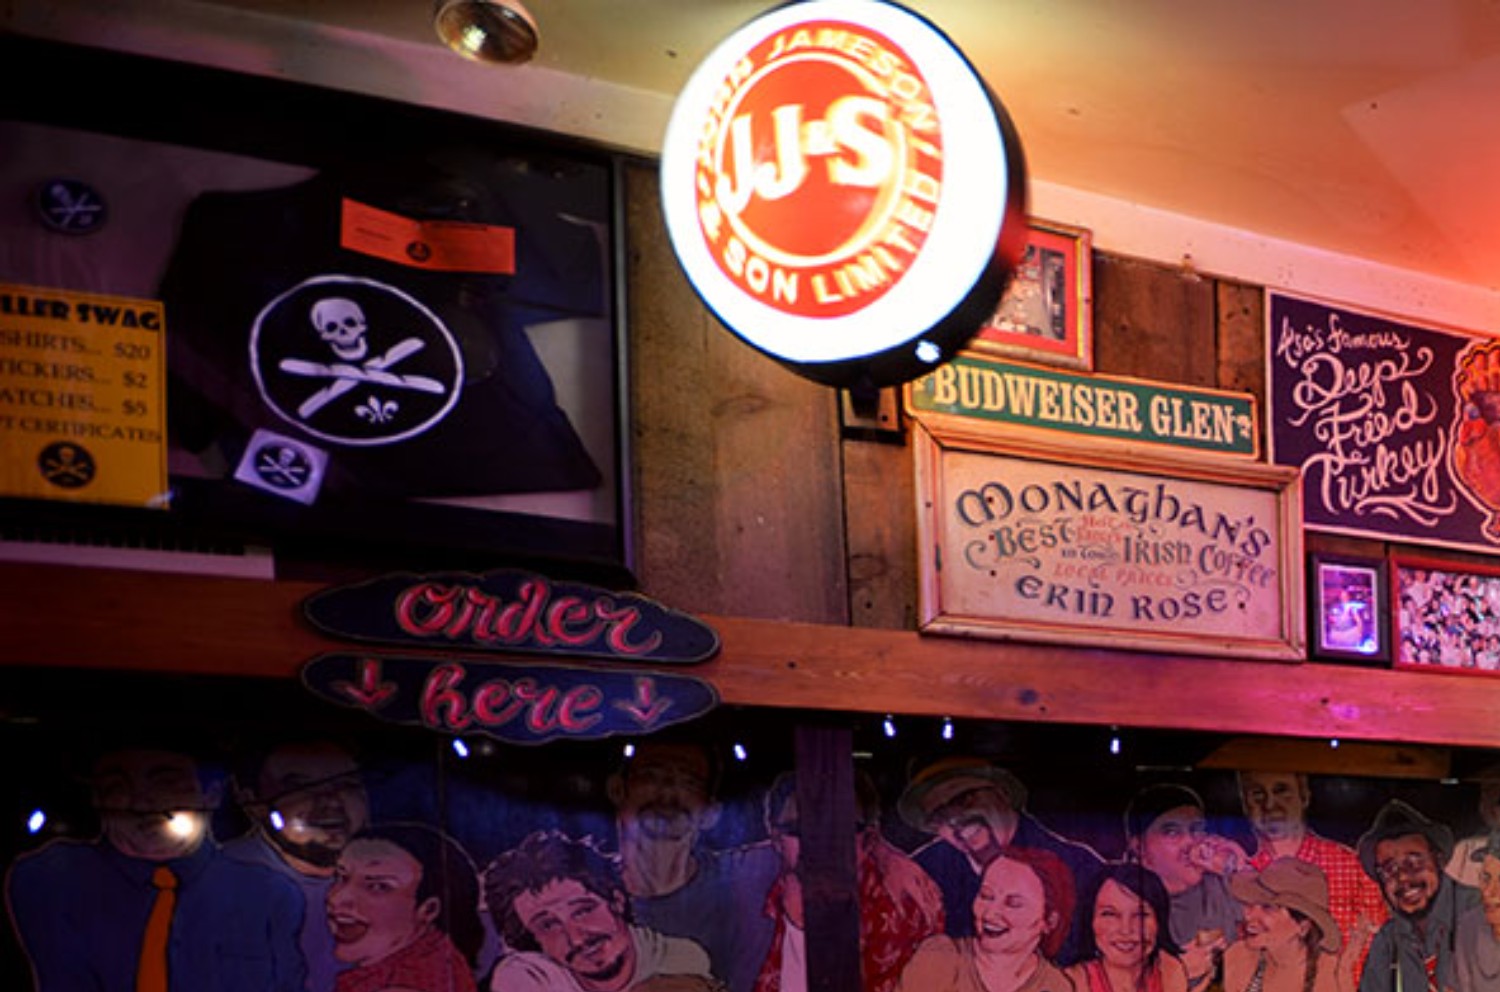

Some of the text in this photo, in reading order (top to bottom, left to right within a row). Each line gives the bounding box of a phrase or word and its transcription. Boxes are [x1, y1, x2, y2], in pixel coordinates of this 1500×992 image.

[766, 27, 941, 131] JAMESON
[722, 235, 798, 304] SON
[811, 168, 941, 305] LIMITED
[0, 293, 161, 332] LLER SWAG
[114, 341, 149, 360] $20
[122, 371, 148, 390] $2
[122, 400, 148, 418] $5
[934, 362, 1235, 445] BUDWEISER GLEN
[1288, 345, 1435, 427] Deep
[1314, 379, 1439, 463] Fried
[1301, 427, 1446, 516] Turkey
[1131, 587, 1229, 623] ROSE
[419, 661, 606, 733] here
